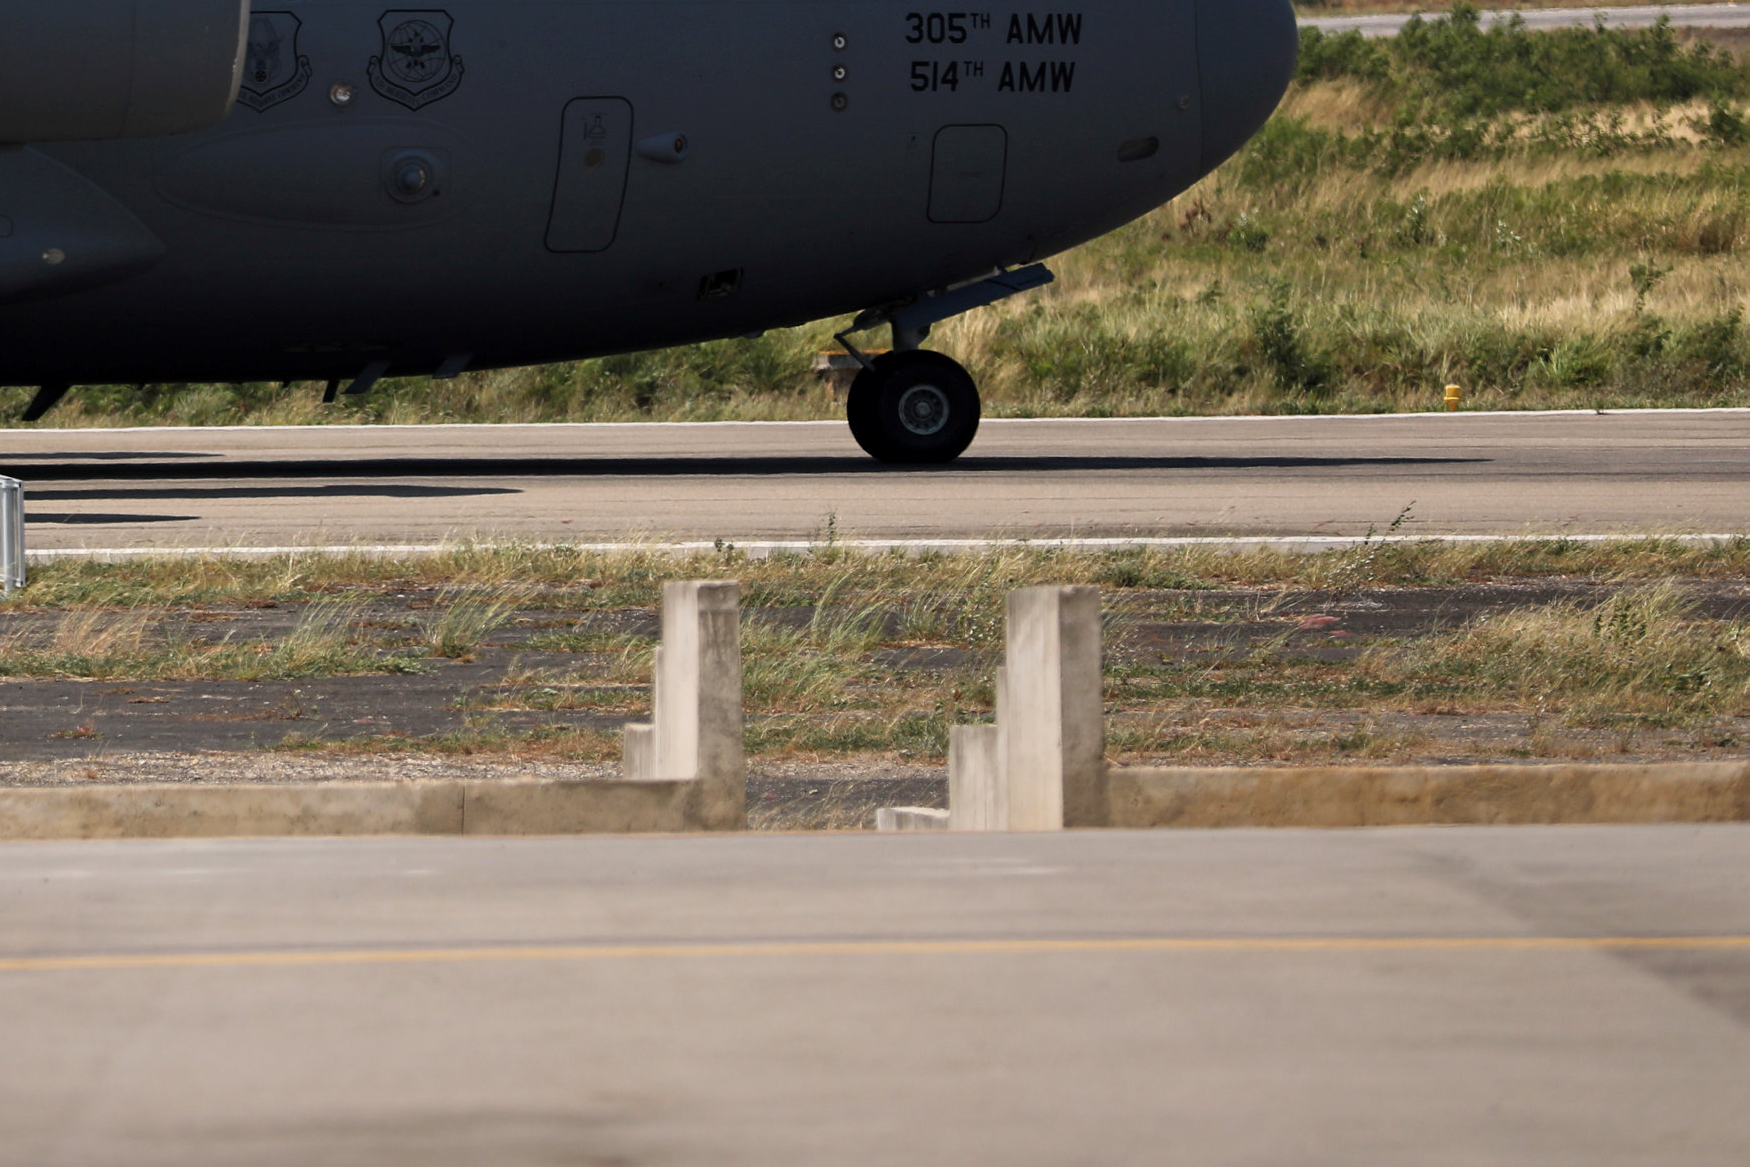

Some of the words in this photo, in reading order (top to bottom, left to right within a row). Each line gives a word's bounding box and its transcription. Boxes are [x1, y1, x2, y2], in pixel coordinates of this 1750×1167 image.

[905, 12, 991, 44] 305TH
[1006, 13, 1082, 45] AMW
[910, 61, 984, 92] 514TH
[997, 61, 1076, 93] AMW
